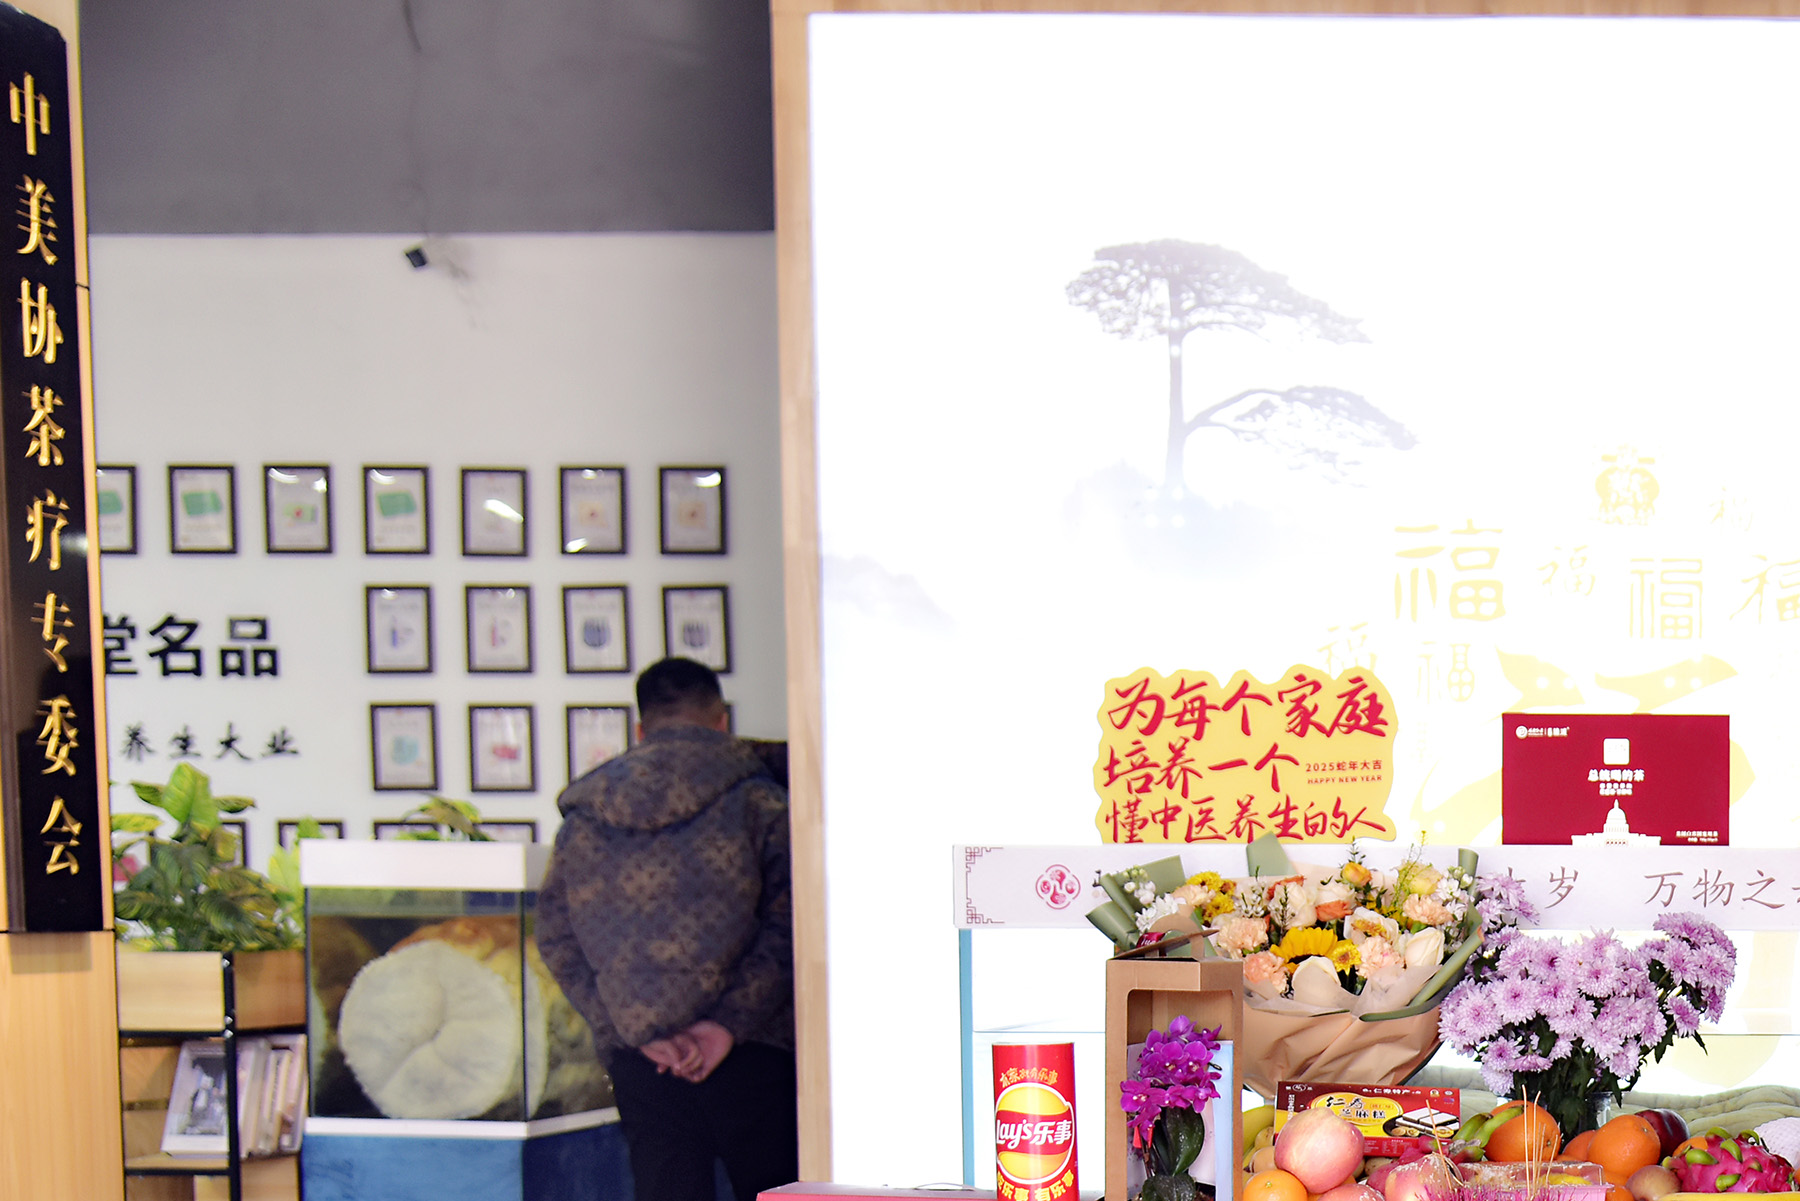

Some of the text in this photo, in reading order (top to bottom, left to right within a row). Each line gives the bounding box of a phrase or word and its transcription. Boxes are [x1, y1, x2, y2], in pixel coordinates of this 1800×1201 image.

[9, 71, 83, 876] 中美协茶疗专委会
[1107, 673, 1389, 741] 为每个家庭
[1103, 737, 1299, 800] 培养一个
[1305, 760, 1383, 773] 2025蛇年大吉
[1307, 774, 1383, 785] HAPPY NEW YEAR
[1105, 794, 1387, 844] 懂中医养生的人
[996, 1119, 1072, 1150] Lay's乐事
